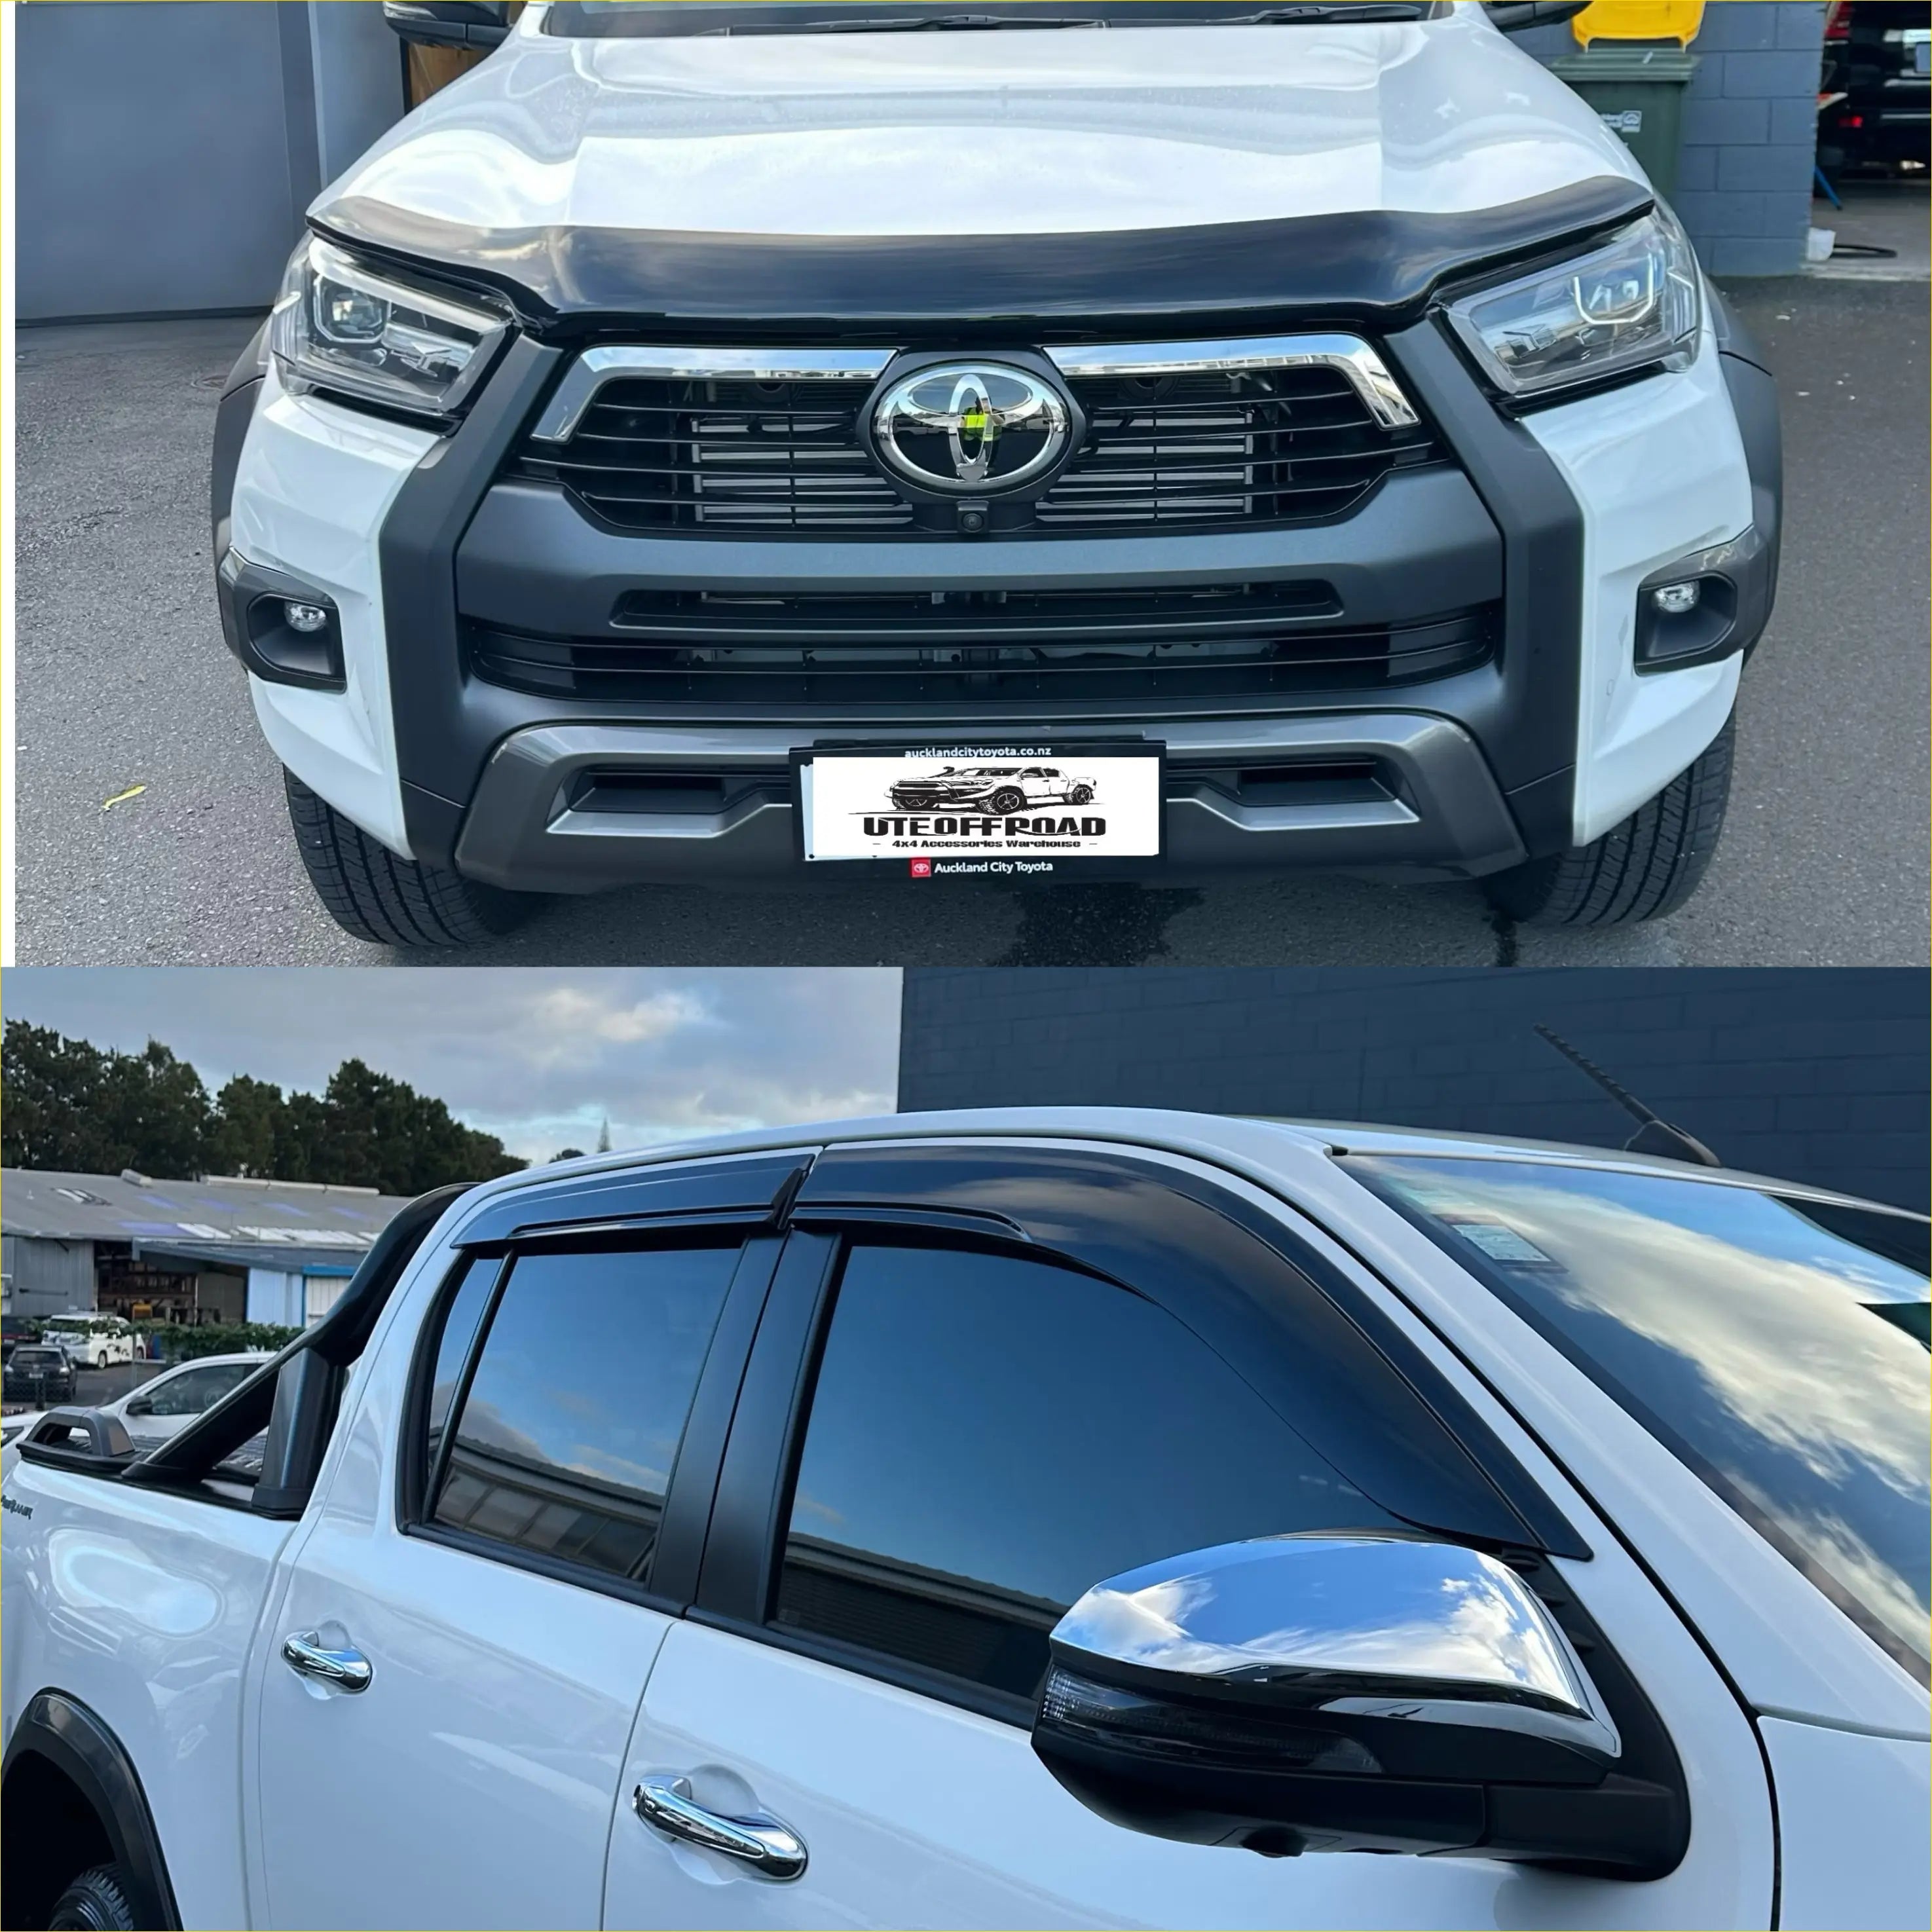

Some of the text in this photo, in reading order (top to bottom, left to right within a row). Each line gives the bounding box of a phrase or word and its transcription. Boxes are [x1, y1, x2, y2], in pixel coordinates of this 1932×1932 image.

[904, 747, 1052, 758] aucklandcitytoyota.co.nz
[934, 861, 1054, 874] Auckland City Toyota
